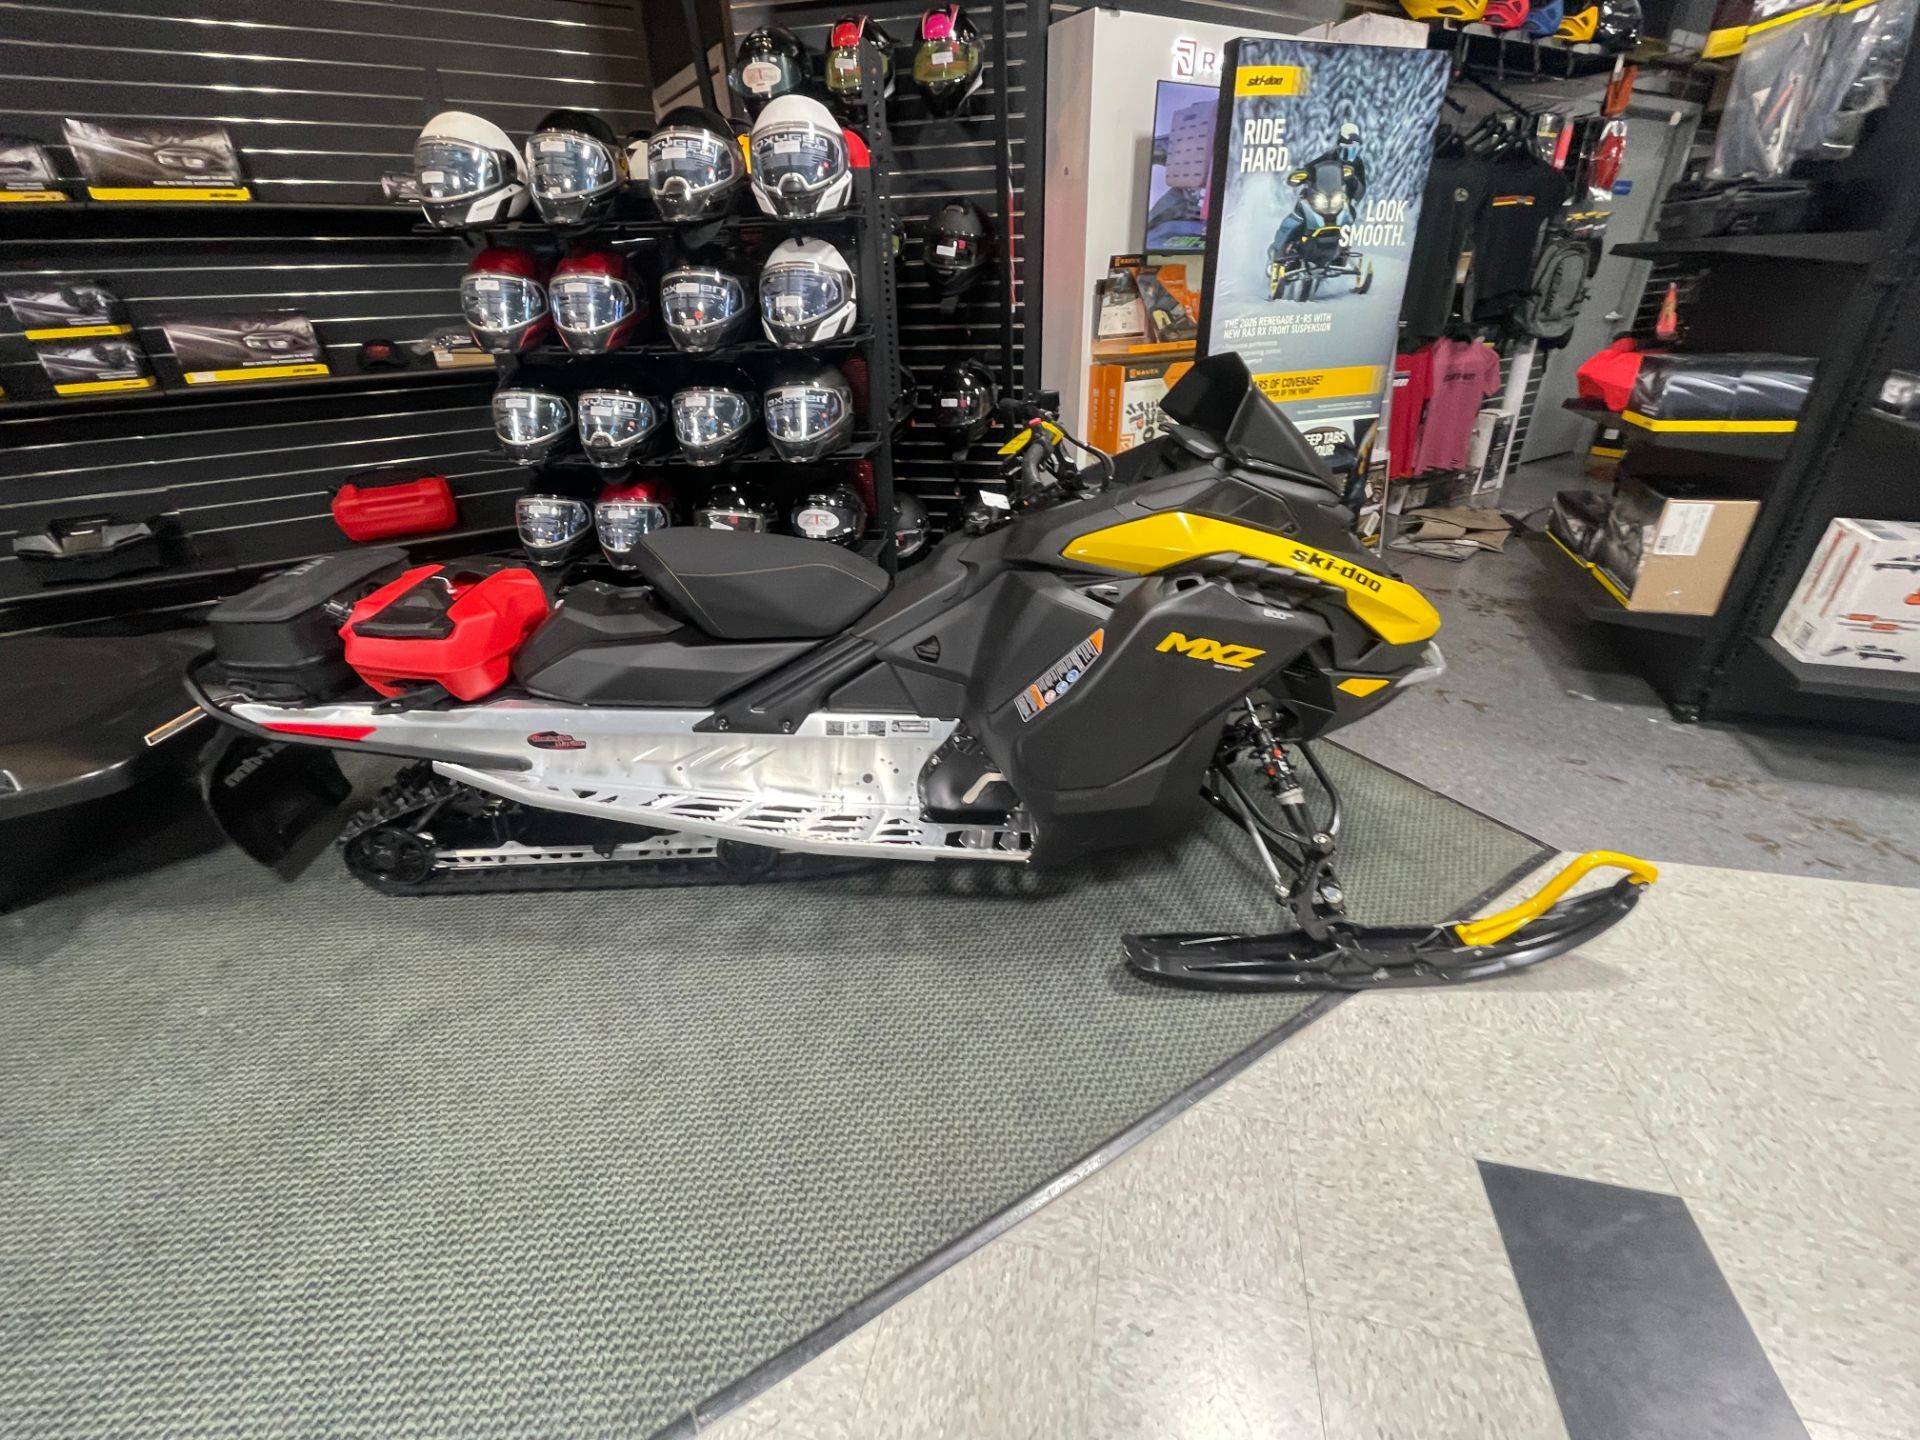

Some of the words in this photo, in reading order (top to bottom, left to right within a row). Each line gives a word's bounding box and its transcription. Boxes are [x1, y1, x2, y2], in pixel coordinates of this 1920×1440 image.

[756, 133, 828, 150] OXYGEN
[1243, 118, 1287, 146] RIDE
[1240, 147, 1292, 173] HARD.
[1366, 199, 1408, 223] LOOK
[1338, 224, 1406, 247] SMOOTH.
[662, 282, 727, 297] OXEN
[1224, 319, 1240, 329] THE
[1258, 315, 1294, 326] RENEGADE
[1313, 313, 1332, 322] WITH
[1224, 329, 1241, 339] NEW
[1242, 327, 1256, 338] RAS
[1256, 326, 1267, 336] RX
[1268, 325, 1290, 335] FRONT
[1290, 322, 1332, 334] SUSPENSION
[1269, 378, 1281, 389] OF
[1323, 430, 1347, 444] TABS
[1289, 548, 1383, 593] ski-doo
[1155, 631, 1267, 669] MXZ
